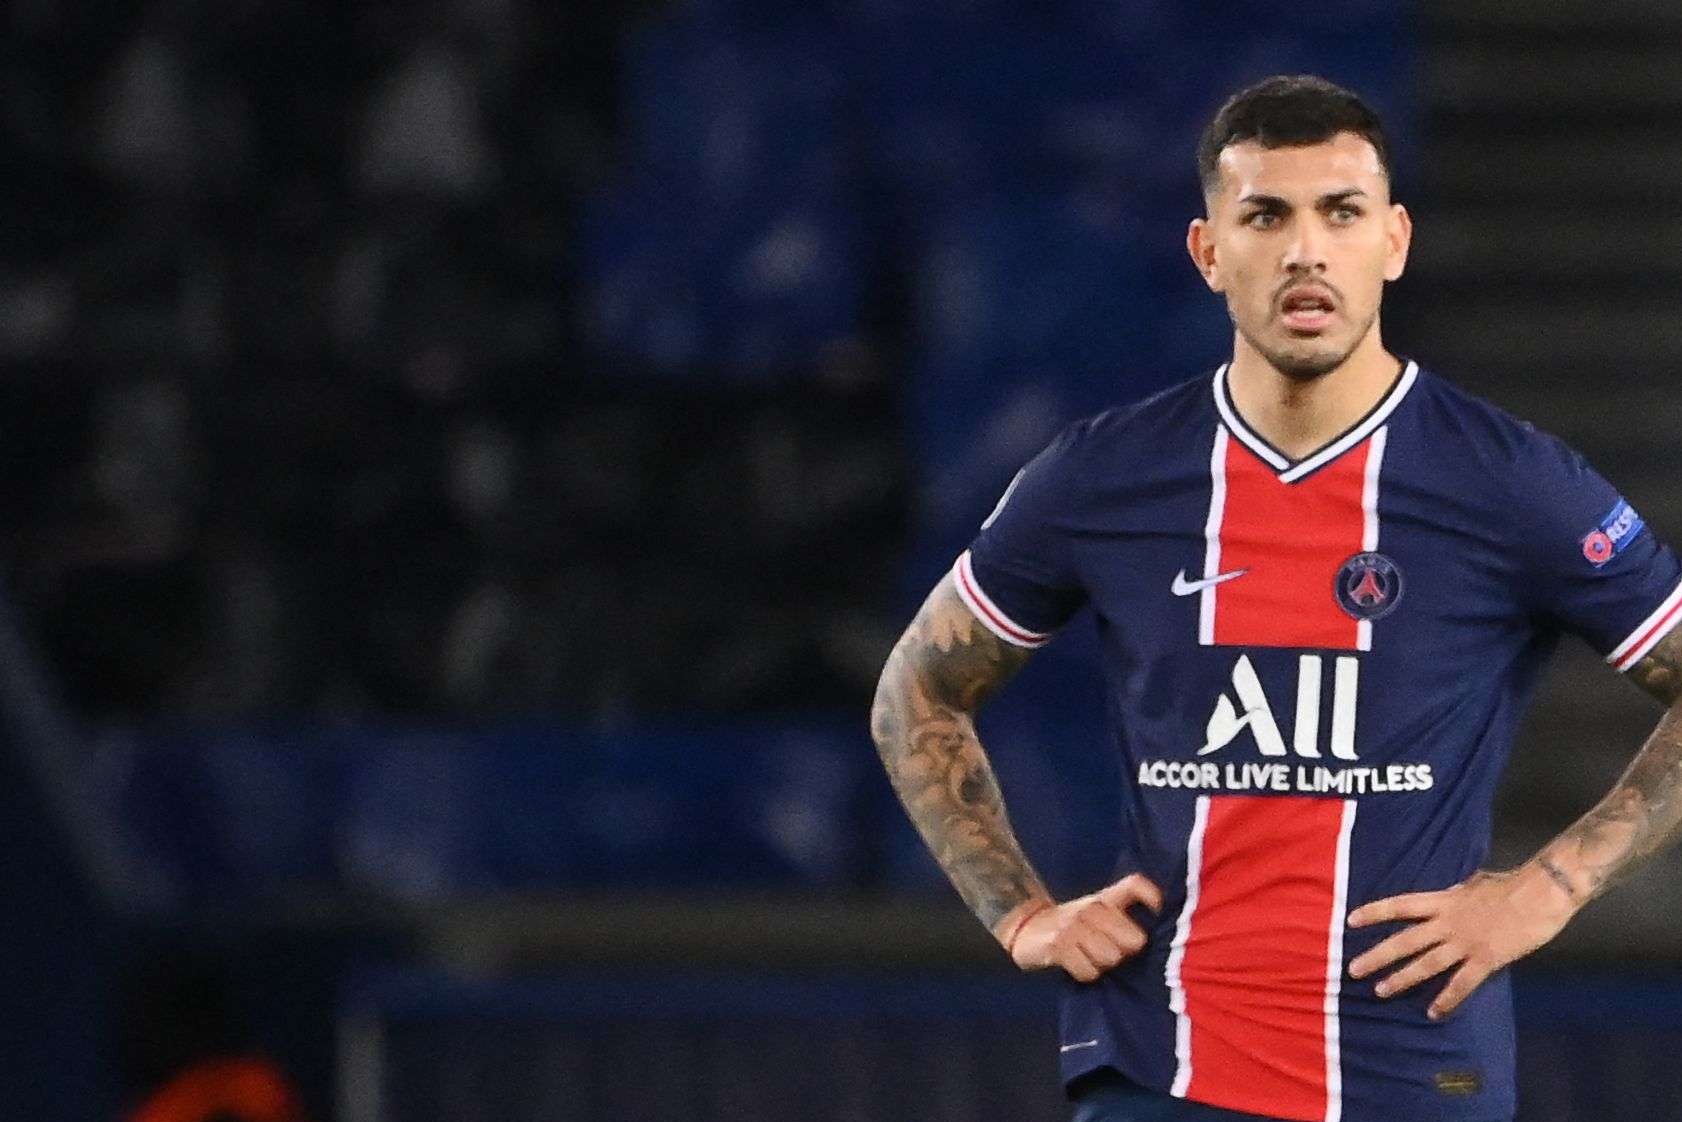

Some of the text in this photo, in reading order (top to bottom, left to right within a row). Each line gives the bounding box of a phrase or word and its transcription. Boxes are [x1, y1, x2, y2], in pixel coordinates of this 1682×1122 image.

[1138, 760, 1434, 793] ACCOR LIVE LIMITLESS
